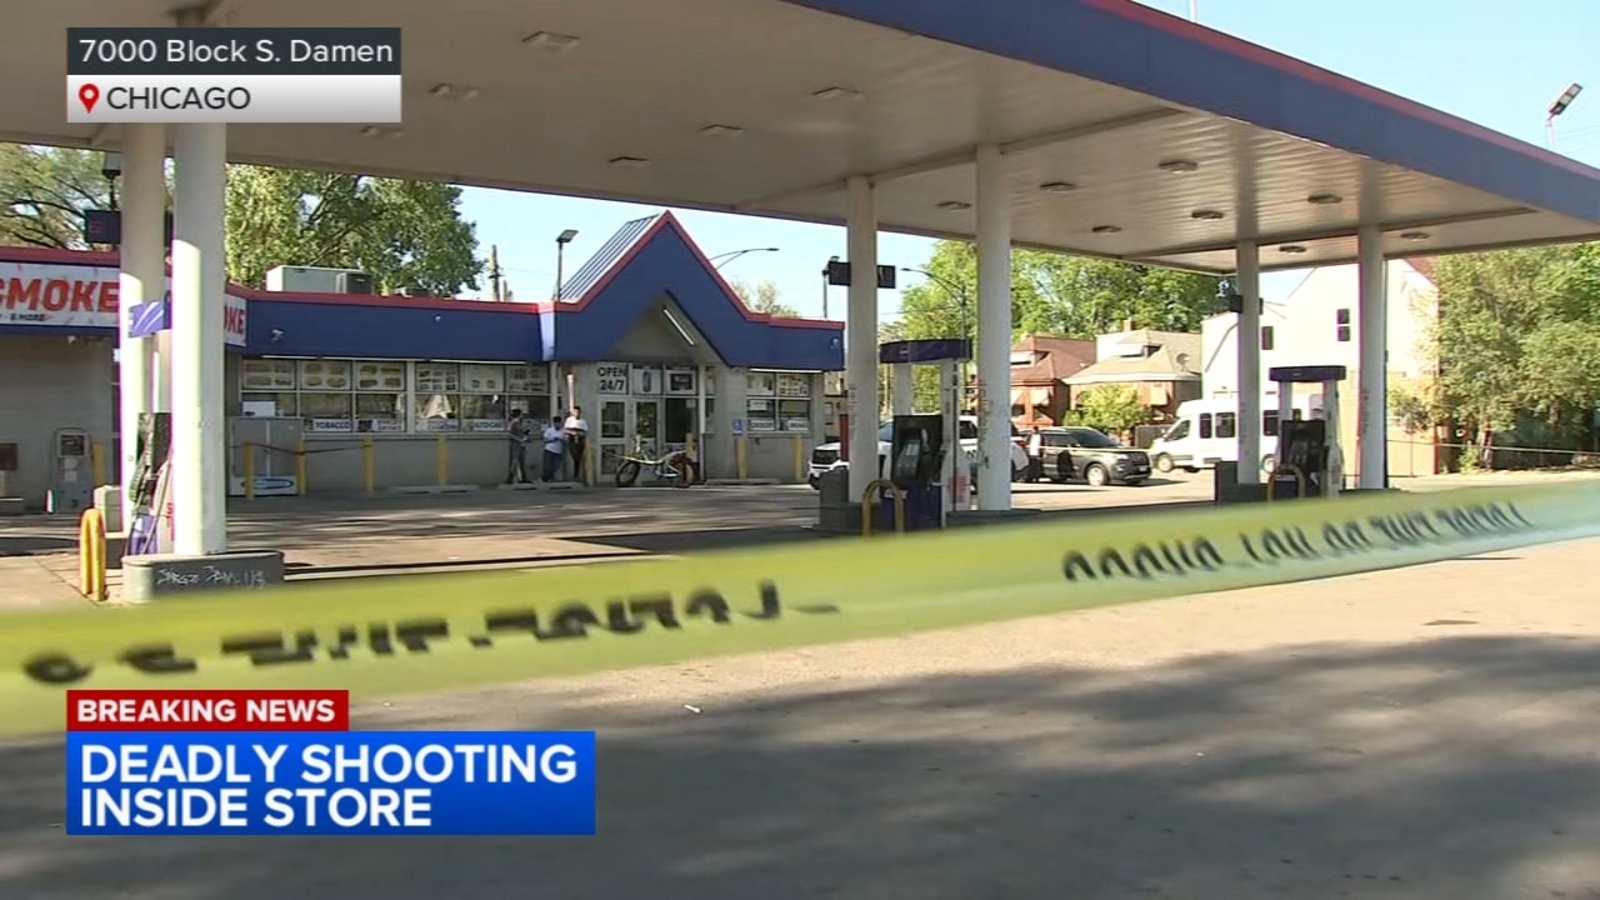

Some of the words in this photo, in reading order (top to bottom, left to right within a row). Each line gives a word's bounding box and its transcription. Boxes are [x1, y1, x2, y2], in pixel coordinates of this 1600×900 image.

[0, 277, 119, 312] MOKE
[597, 366, 627, 377] OPEN
[599, 379, 624, 391] 24/7
[315, 421, 350, 429] TOBACCO
